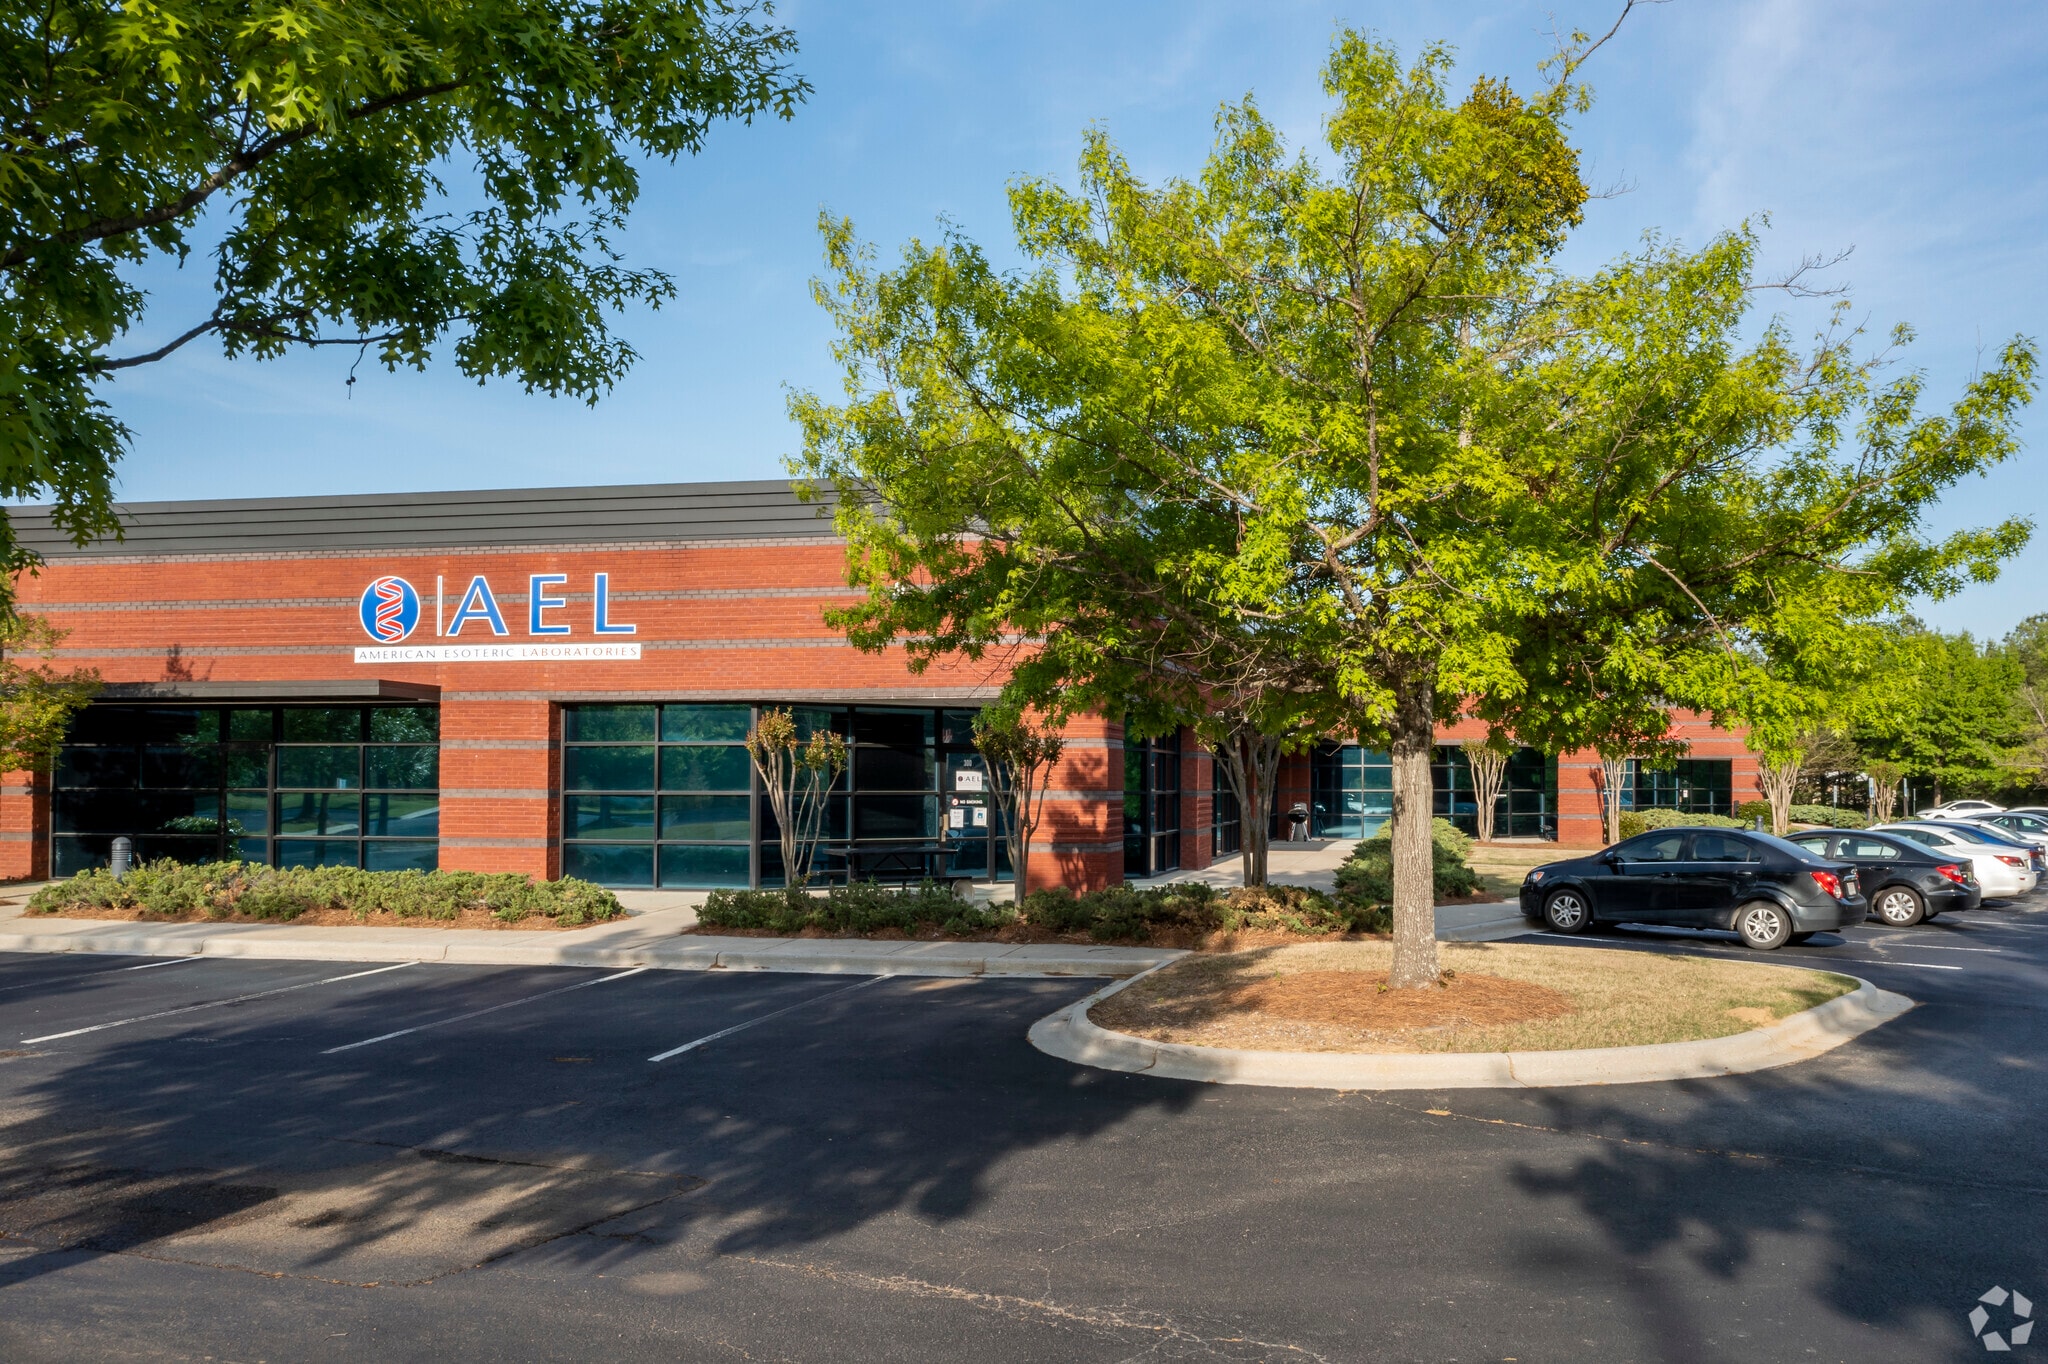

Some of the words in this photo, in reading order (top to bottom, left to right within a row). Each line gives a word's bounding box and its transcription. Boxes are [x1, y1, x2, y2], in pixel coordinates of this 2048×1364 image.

[445, 572, 637, 637] AEL
[359, 649, 436, 660] AMERICAN
[444, 648, 515, 659] ESOTERIC
[522, 646, 638, 657] LABORATORIES
